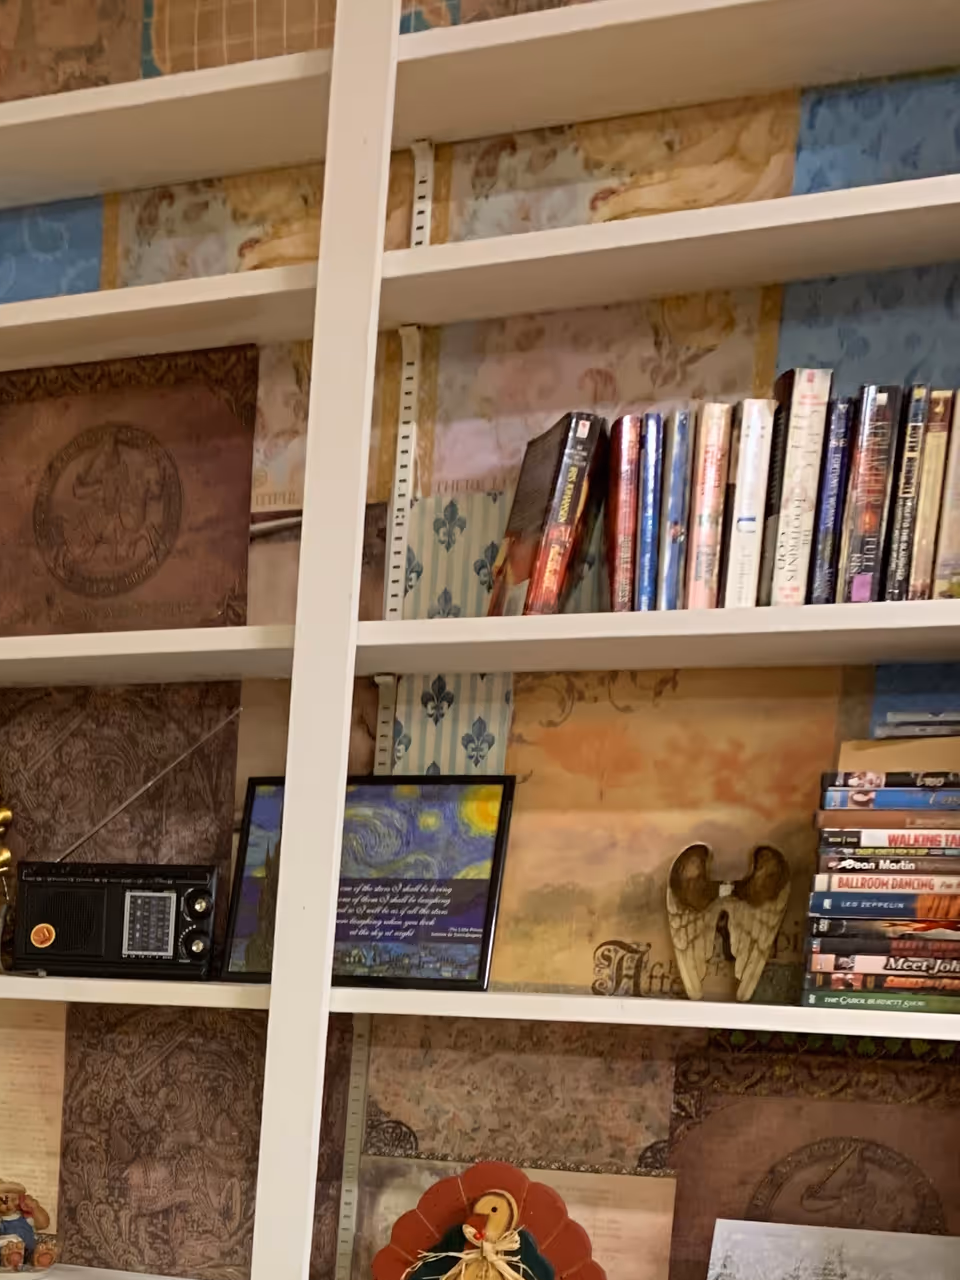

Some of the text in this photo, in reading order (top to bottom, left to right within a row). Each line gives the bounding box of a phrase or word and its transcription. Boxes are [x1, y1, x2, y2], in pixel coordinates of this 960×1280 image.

[901, 424, 923, 496] RUTH RENDELL
[558, 483, 577, 523] JOHANSEN
[786, 498, 806, 582] FOOTPRINTS
[863, 537, 878, 569] FULL
[888, 834, 960, 847] WALKING TA
[844, 859, 875, 870] Dean
[878, 860, 916, 870] Martin
[838, 877, 890, 889] BALLROOM
[891, 878, 935, 890] DANCING
[861, 901, 905, 909] ZEPPELIN
[394, 929, 416, 940] night
[591, 940, 683, 996] Afte
[886, 957, 931, 971] Meet
